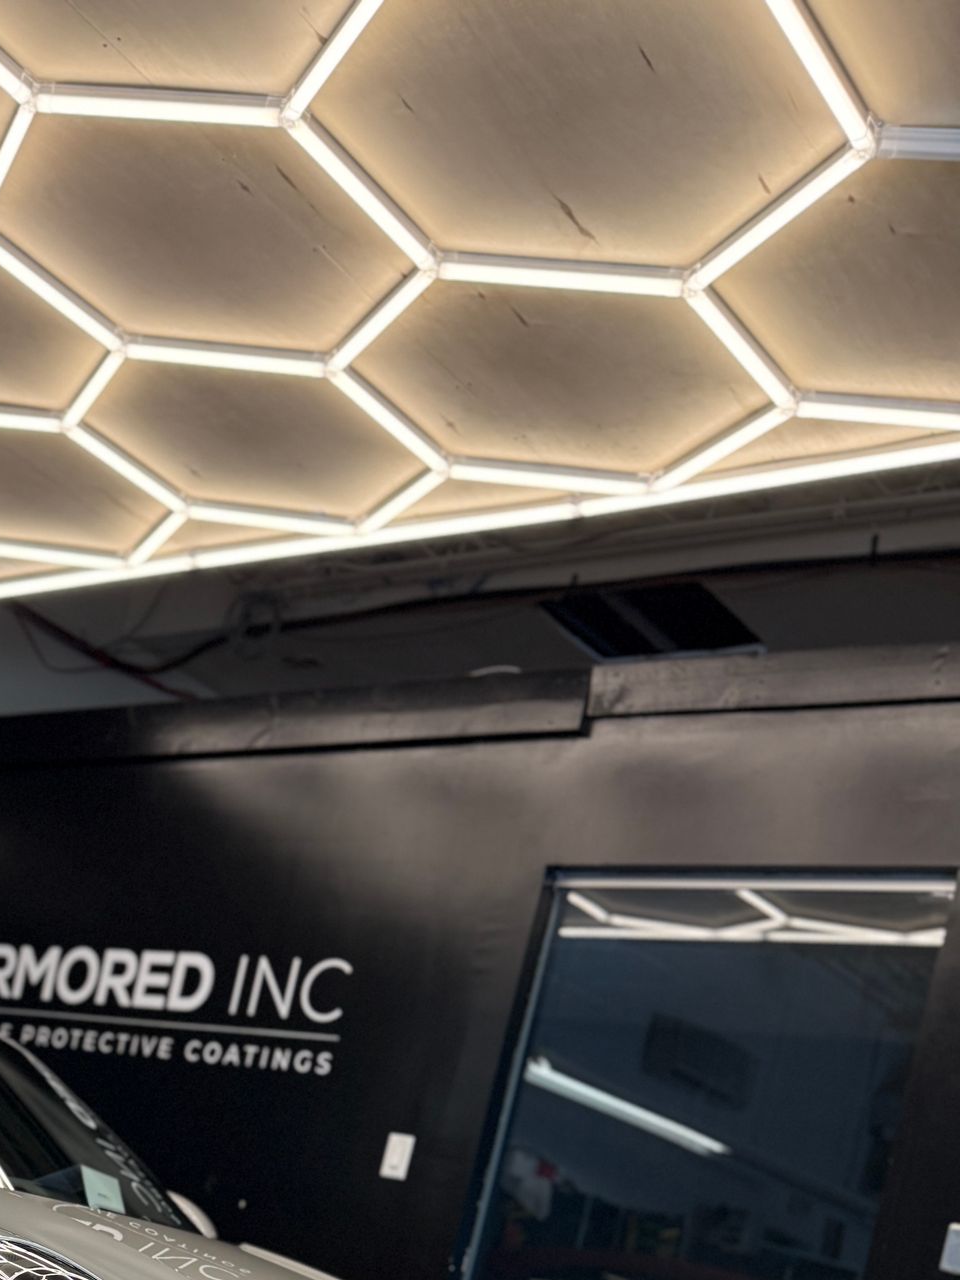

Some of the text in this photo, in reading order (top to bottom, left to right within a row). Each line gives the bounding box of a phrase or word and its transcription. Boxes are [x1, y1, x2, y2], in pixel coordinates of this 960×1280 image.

[227, 953, 354, 1024] INC
[19, 1024, 174, 1061] PROTECTIVE
[183, 1039, 334, 1076] COATINGS
